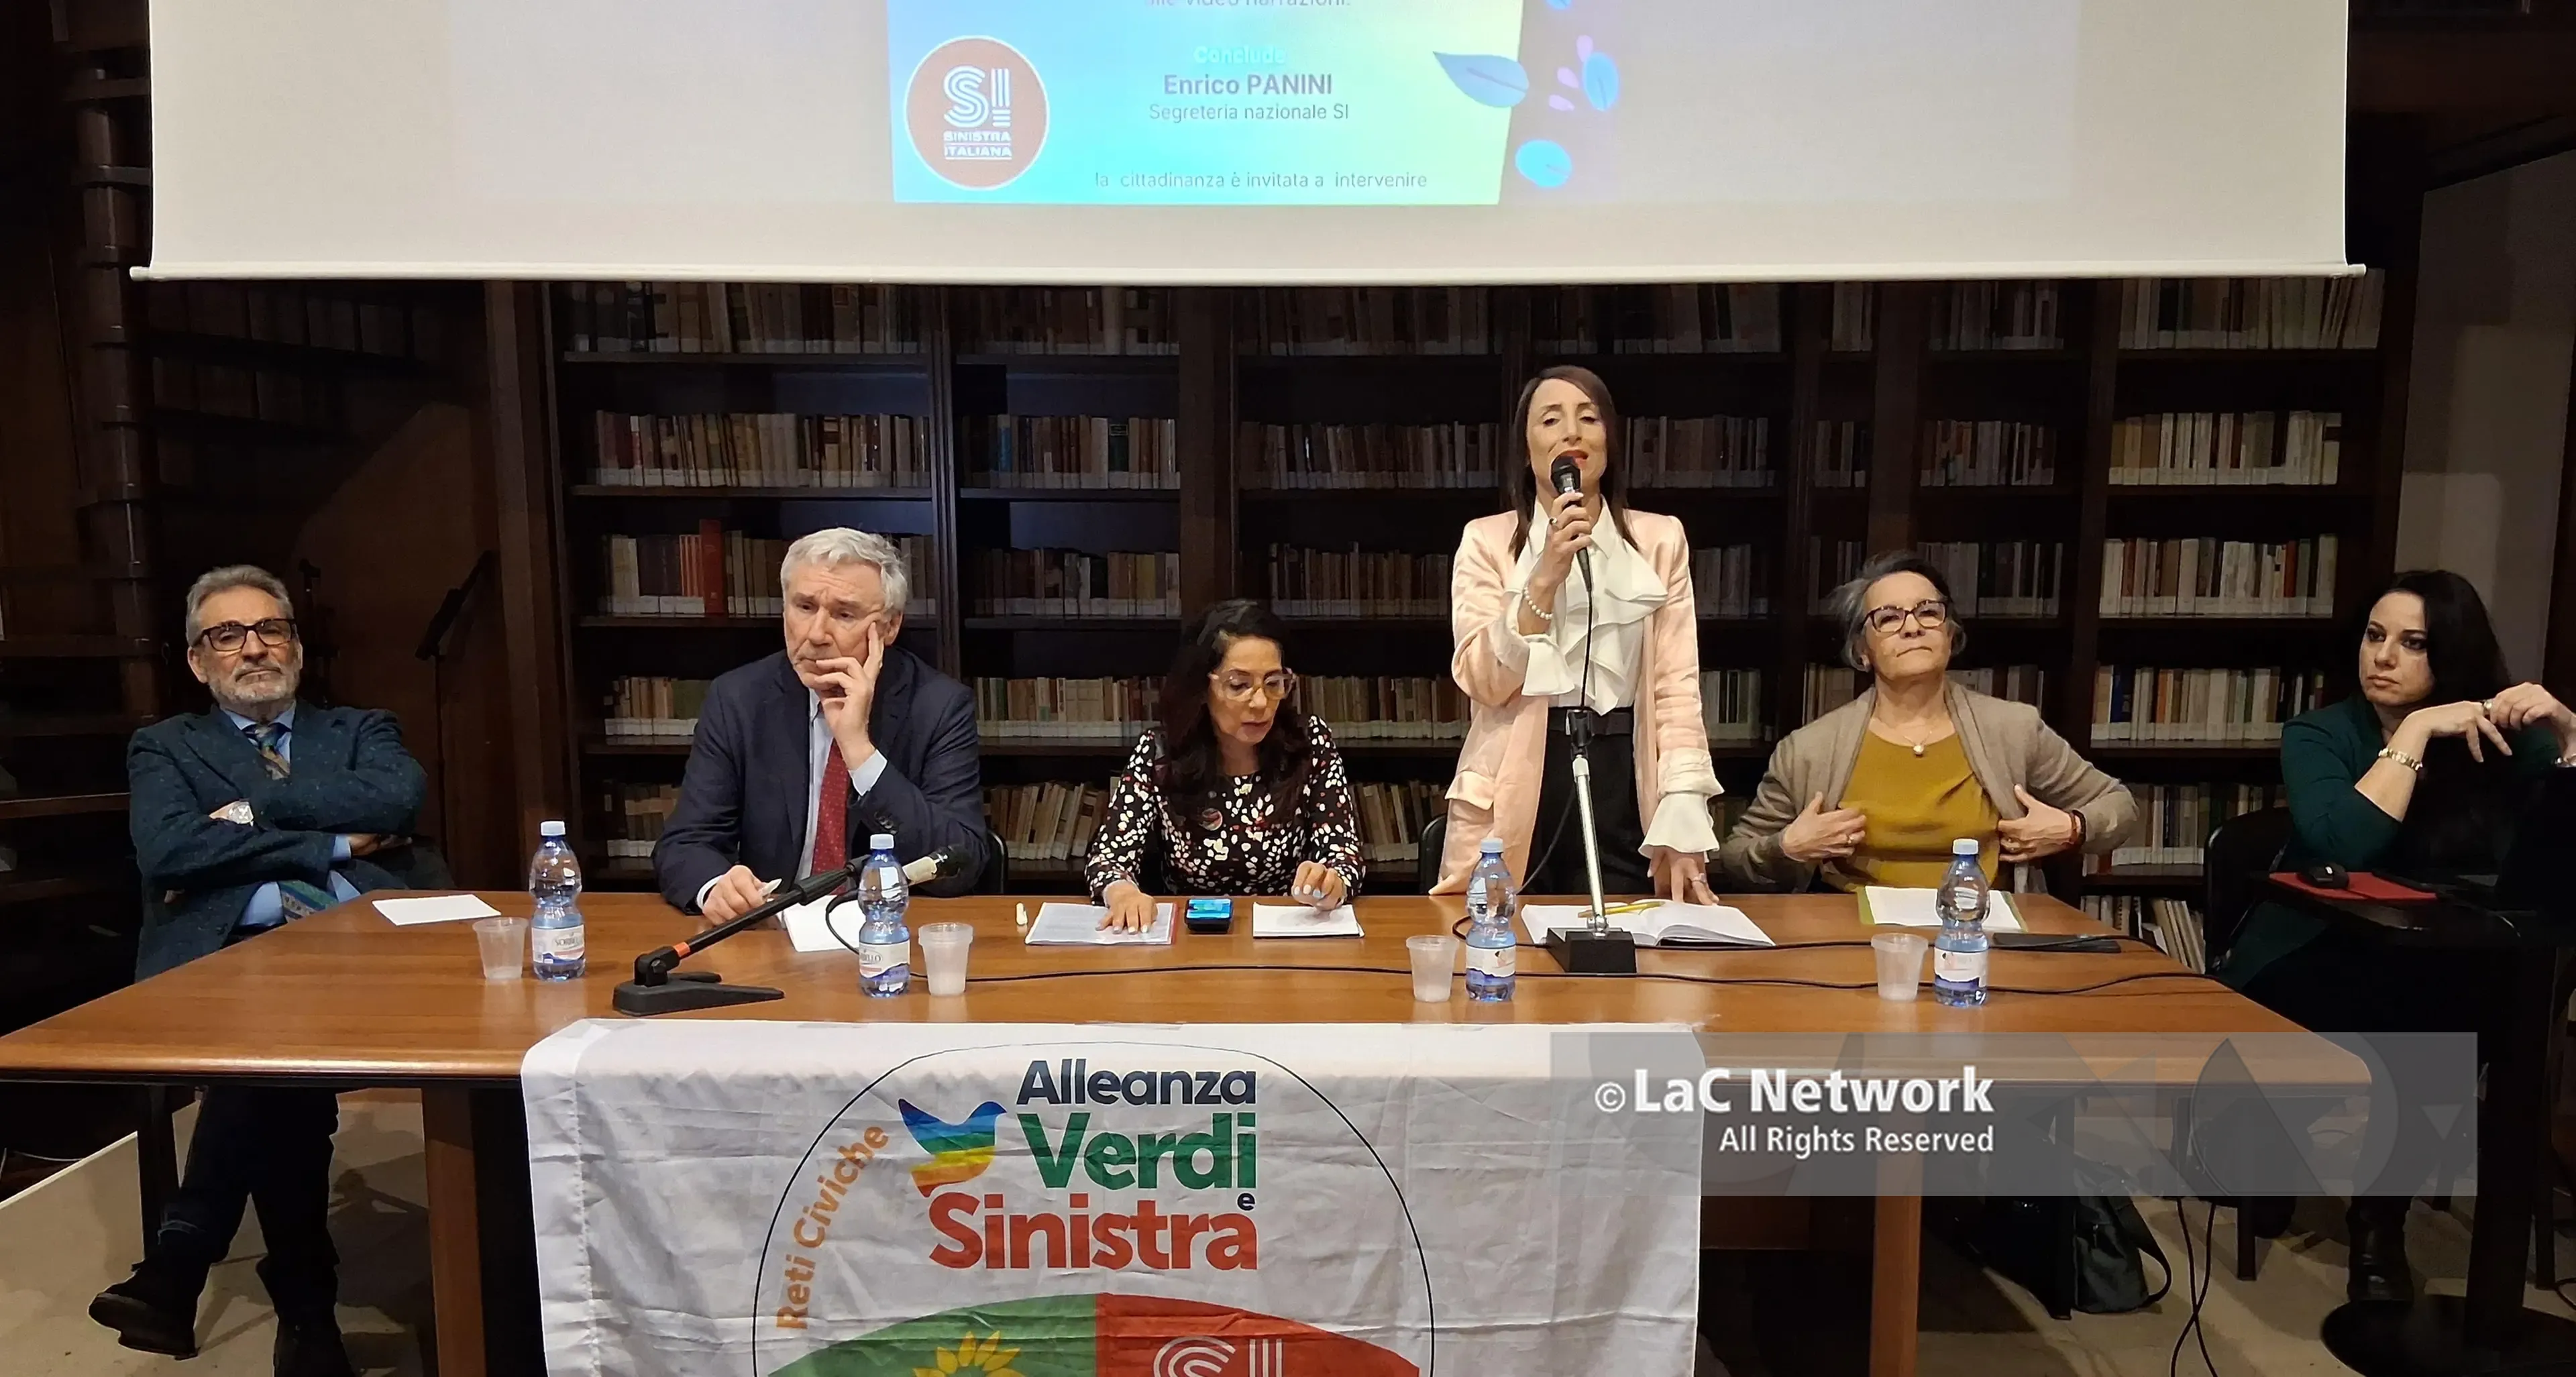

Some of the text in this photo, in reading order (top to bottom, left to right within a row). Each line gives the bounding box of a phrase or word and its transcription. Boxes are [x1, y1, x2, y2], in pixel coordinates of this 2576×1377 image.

[1164, 74, 1332, 95] Enrico PANINI
[1149, 103, 1348, 123] Segreteria nazionale SI
[943, 130, 1012, 142] SINISTRA
[944, 146, 1012, 157] ITALIANA
[1095, 172, 1109, 188] la
[1120, 170, 1225, 188] cittadinanza
[1246, 172, 1308, 188] invitata
[1314, 175, 1324, 188] a
[1335, 172, 1428, 188] intervenire
[1016, 1058, 1256, 1105] Alleanza
[1017, 1112, 1256, 1190] Verdi
[1237, 1193, 1256, 1211] e
[776, 1125, 890, 1329] Reti Civiche
[928, 1191, 1258, 1270] Sinistra
